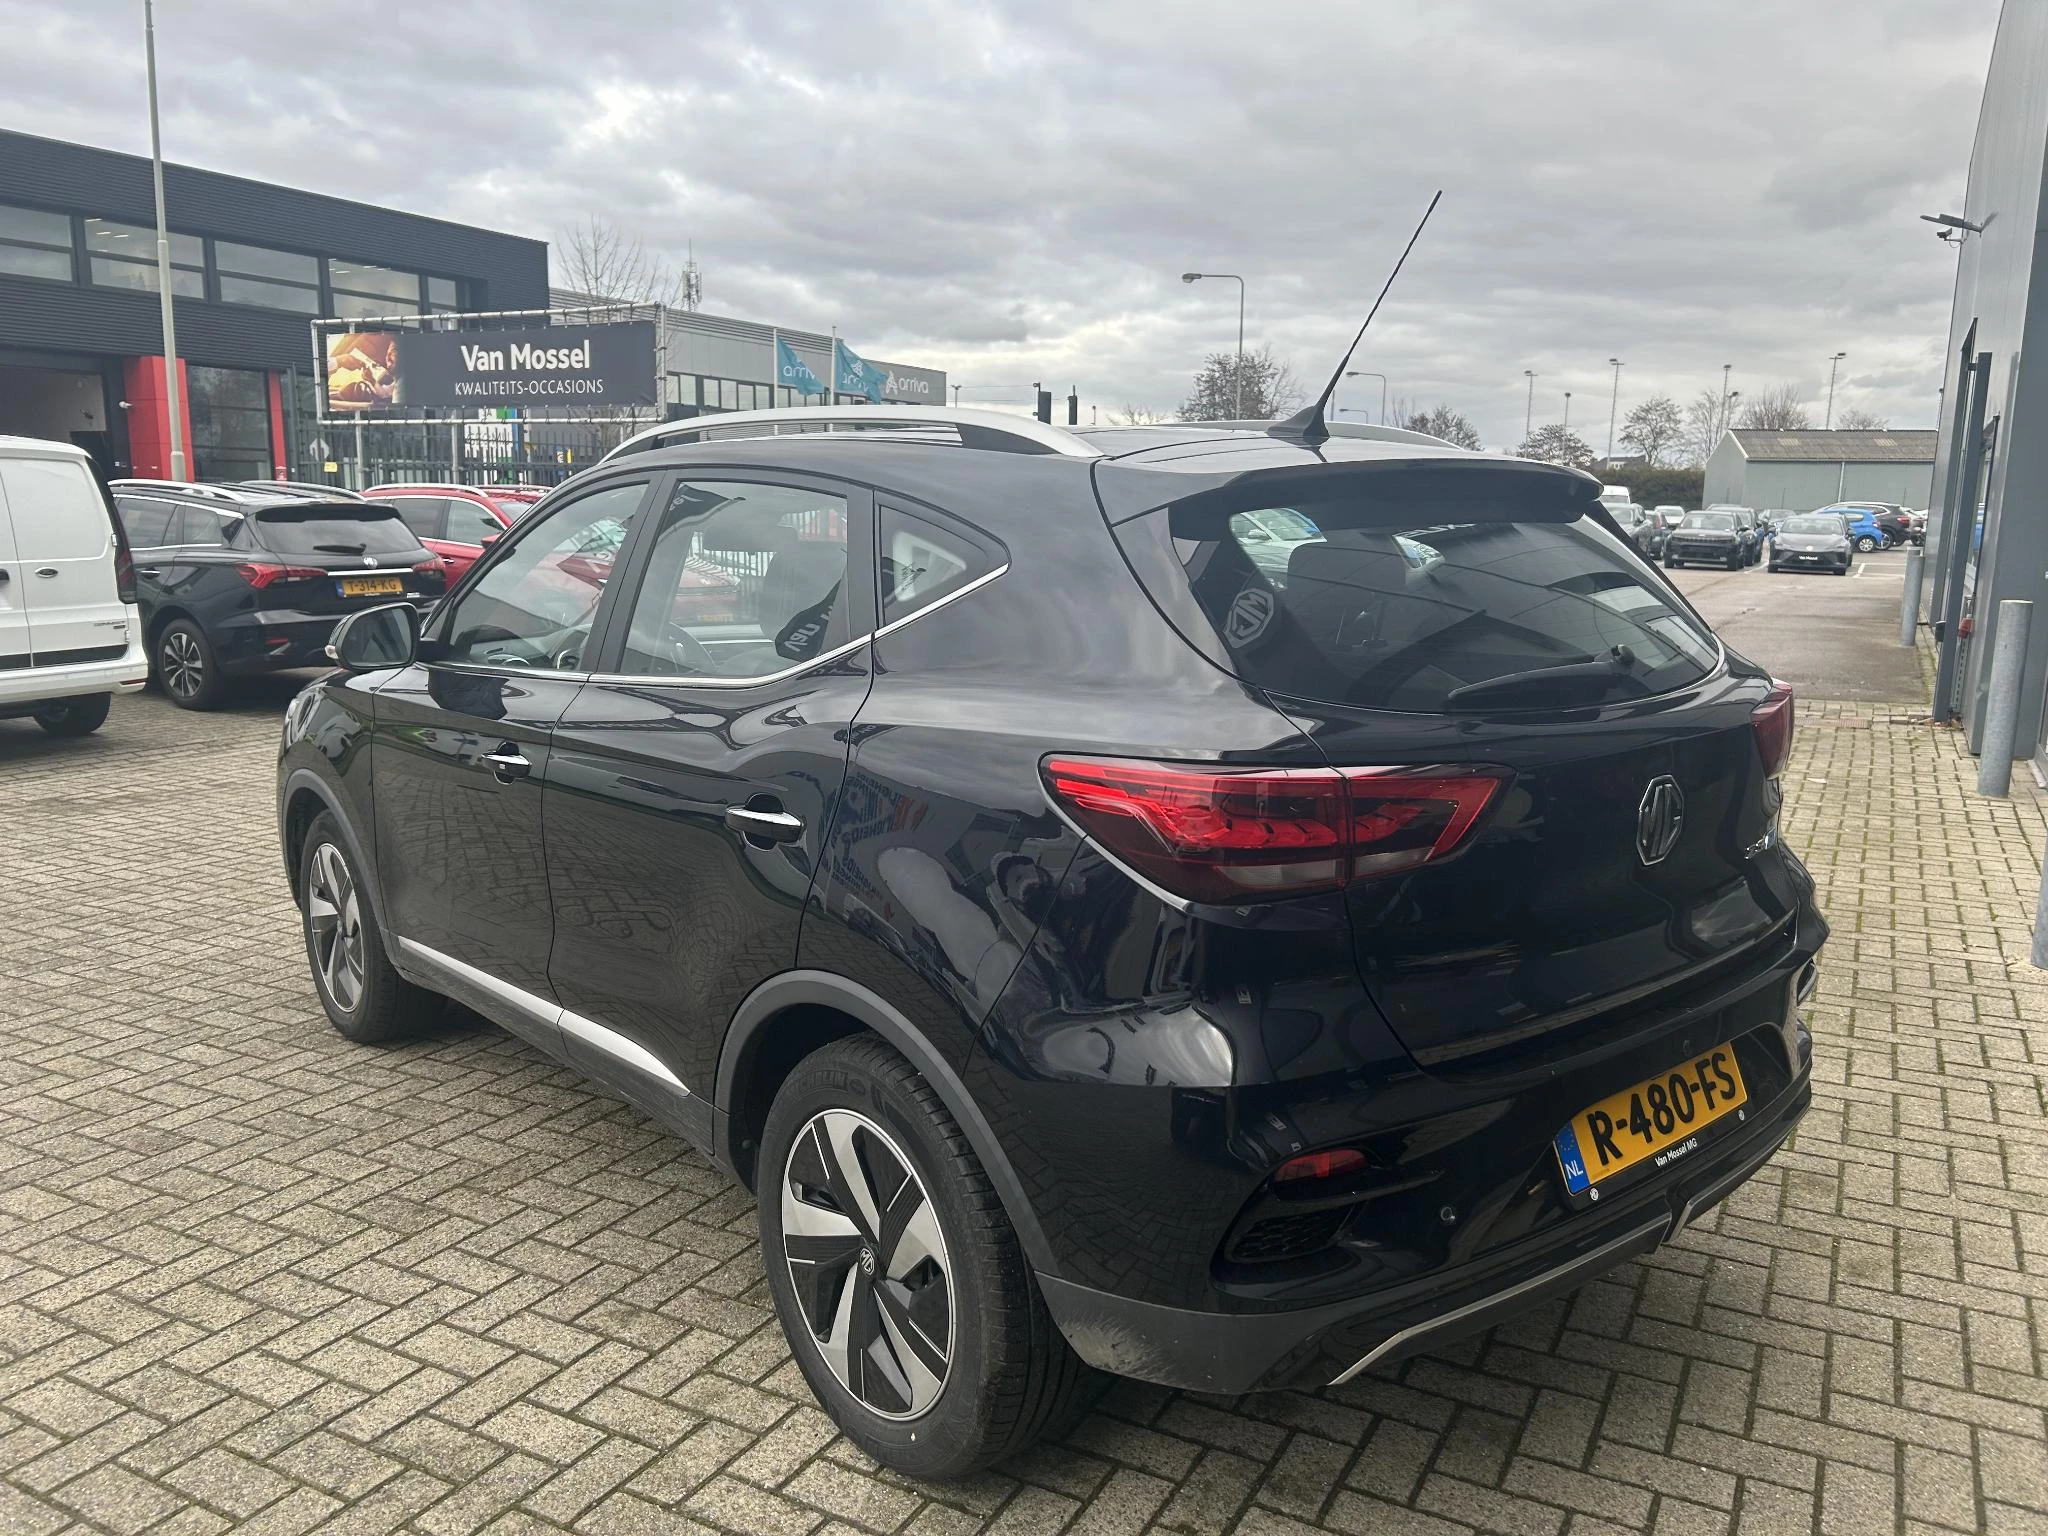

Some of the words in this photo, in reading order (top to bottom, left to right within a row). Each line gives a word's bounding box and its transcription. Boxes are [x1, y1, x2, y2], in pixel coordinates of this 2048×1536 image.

[460, 344, 504, 372] Van
[509, 339, 590, 371] Mossel
[455, 378, 604, 396] KWALITEITS-OCCASIONS
[899, 376, 929, 394] arriva
[347, 579, 397, 592] T-314-KG
[1587, 1052, 1736, 1167] R-480-FS
[1655, 1155, 1668, 1167] Van
[1667, 1142, 1688, 1161] Mossel
[1686, 1137, 1698, 1150] MG
[1565, 1160, 1584, 1180] NL
